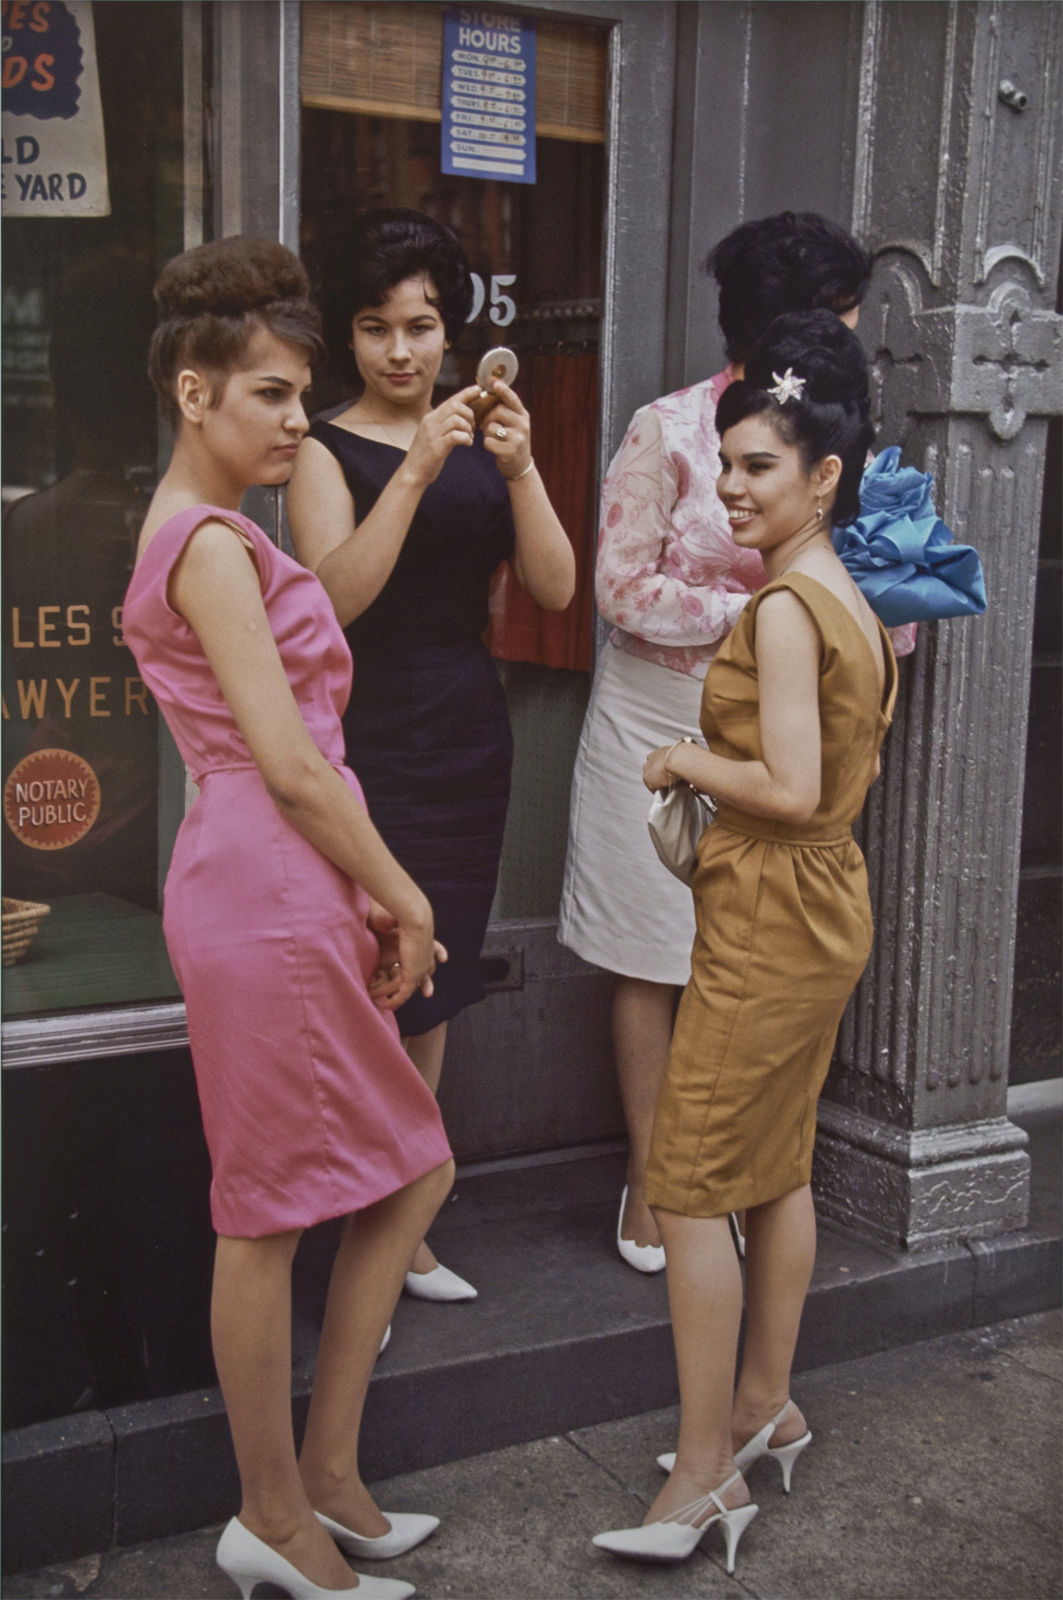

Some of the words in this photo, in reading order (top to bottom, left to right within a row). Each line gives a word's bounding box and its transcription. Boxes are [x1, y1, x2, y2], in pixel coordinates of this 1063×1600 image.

[1, 1, 50, 32] ES
[459, 26, 521, 54] HOURS
[15, 172, 87, 201] YARD
[12, 605, 91, 648] LES
[16, 778, 89, 803] NOTARY
[19, 802, 87, 827] PUBLIC
